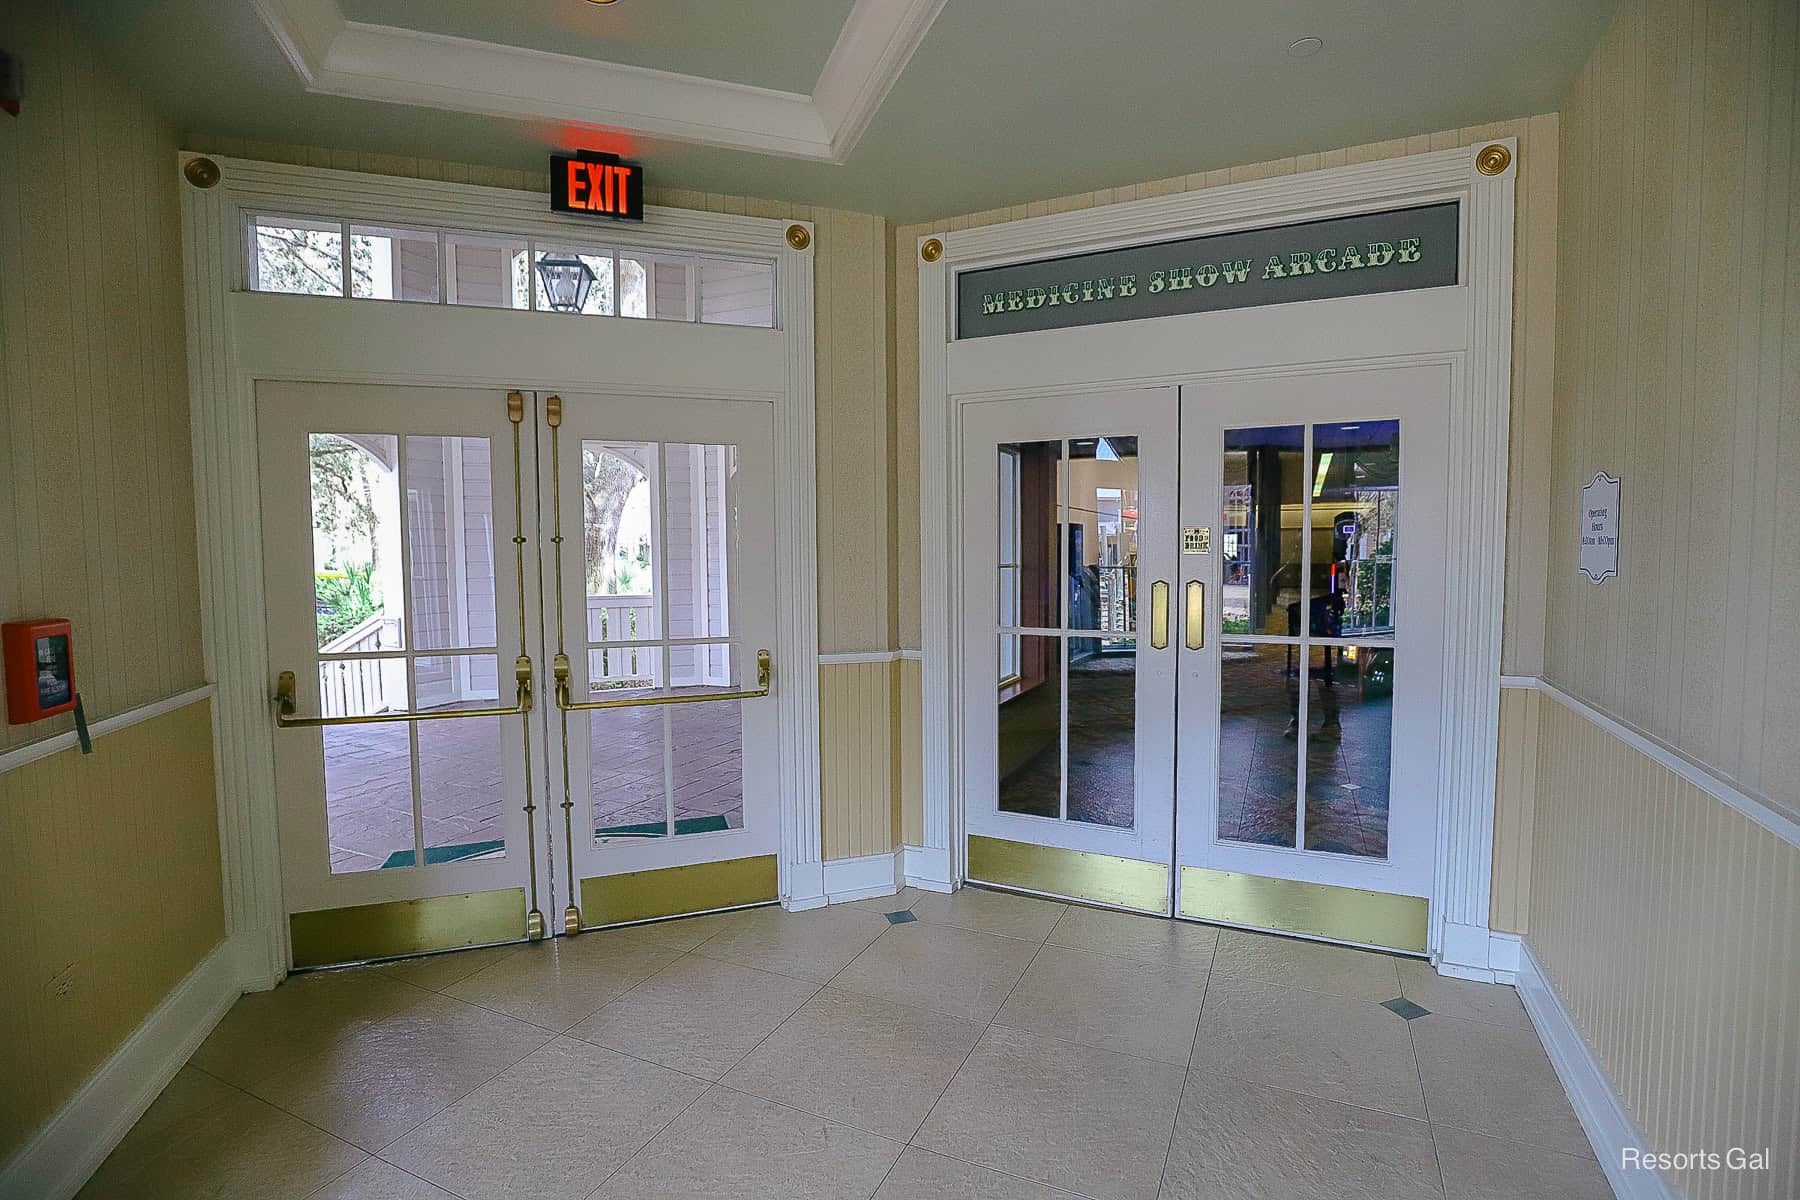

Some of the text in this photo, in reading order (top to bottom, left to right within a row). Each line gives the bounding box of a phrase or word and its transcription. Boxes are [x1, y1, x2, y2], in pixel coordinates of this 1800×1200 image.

[567, 160, 632, 214] EXIT
[982, 237, 1421, 315] MEDICINE SHOW ARCADE
[1588, 506, 1608, 520] Operating
[1591, 522, 1604, 532] Hours
